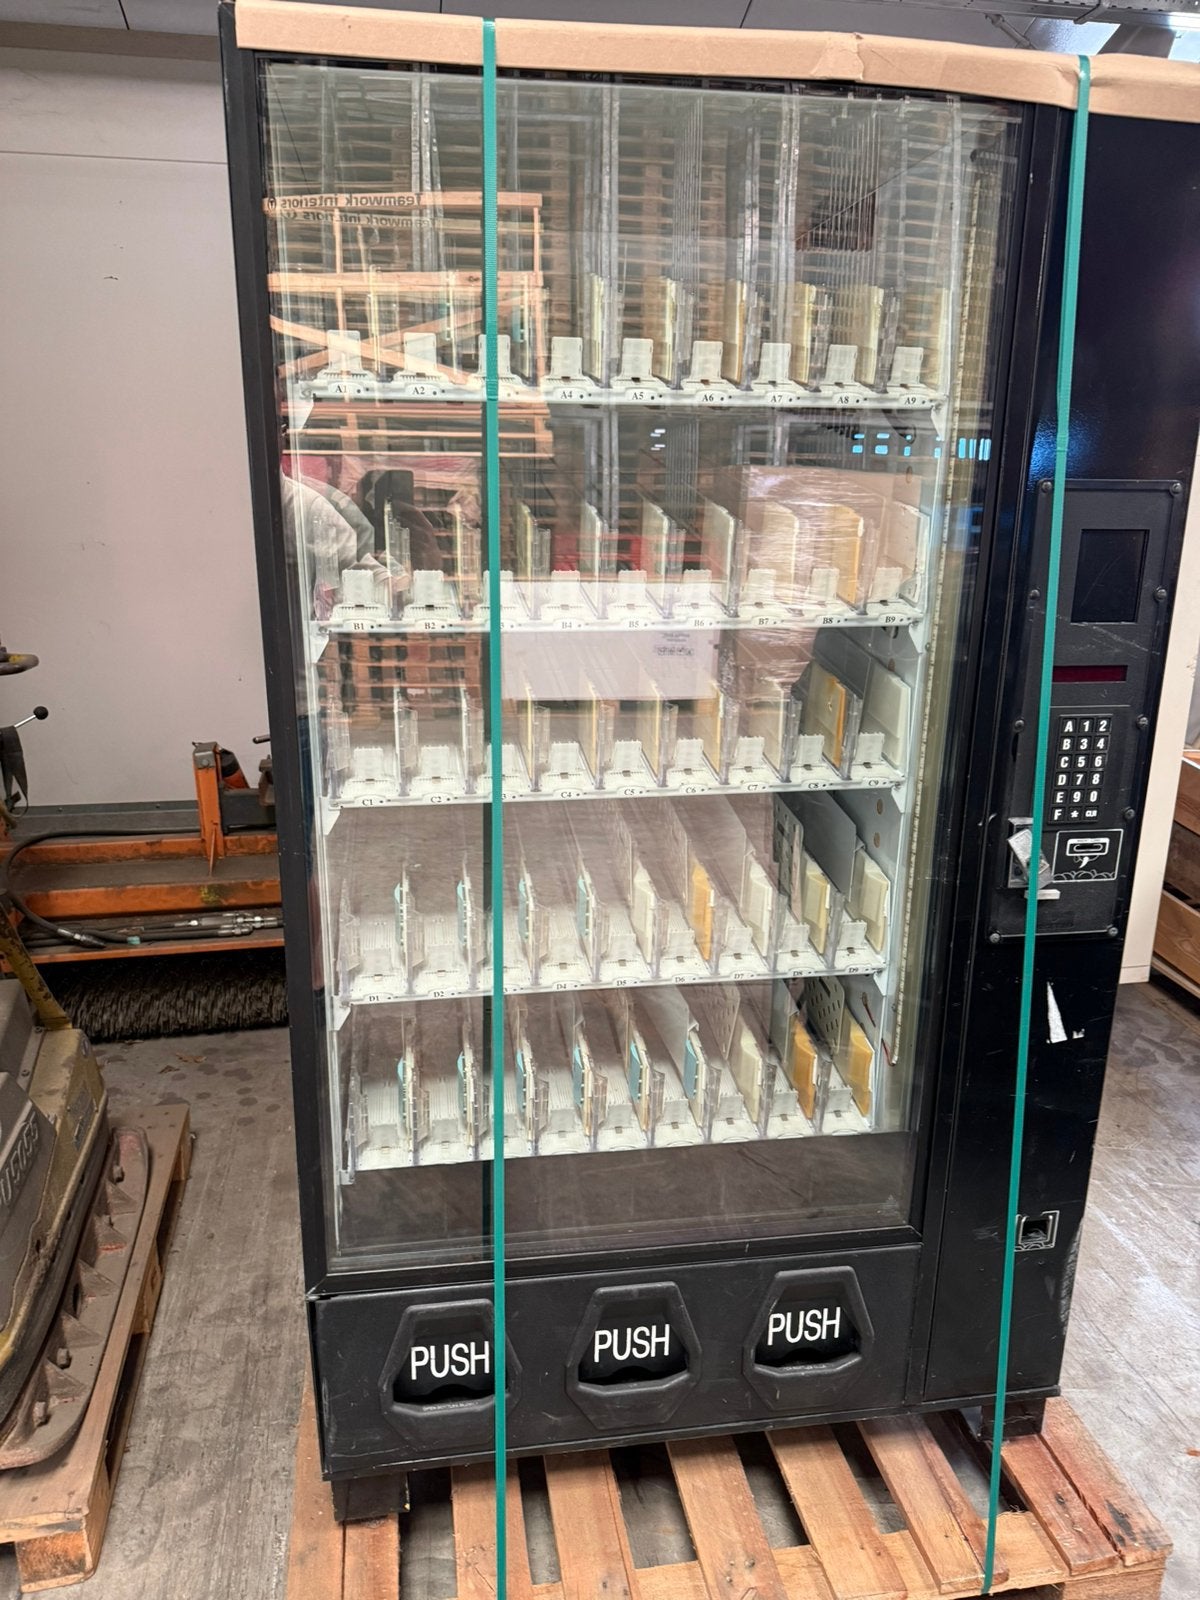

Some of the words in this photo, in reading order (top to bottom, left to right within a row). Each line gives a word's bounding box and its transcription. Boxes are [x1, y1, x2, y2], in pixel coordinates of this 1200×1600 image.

[335, 385, 347, 393] A1
[412, 386, 425, 395] A2
[560, 390, 573, 399] A4
[631, 391, 644, 400] A5
[702, 394, 714, 402] A6
[770, 395, 783, 403] A7
[837, 396, 849, 404] A8
[904, 397, 917, 405] A9
[424, 622, 436, 630] B2
[694, 619, 705, 627] B6
[822, 617, 833, 625] B8
[1064, 721, 1073, 732] A
[1083, 721, 1089, 731] 1
[1098, 720, 1107, 731] 2
[1062, 739, 1071, 750] B
[1079, 739, 1088, 749] 3
[1096, 738, 1104, 749] 4
[1060, 757, 1068, 768] C
[1077, 756, 1085, 767] 5
[1094, 756, 1102, 767] 6
[1057, 775, 1066, 785] D
[1075, 774, 1083, 785] 7
[1091, 774, 1100, 784] 8
[1055, 792, 1064, 802] E
[1072, 792, 1081, 802] 9
[1089, 791, 1097, 802] 0
[1053, 809, 1062, 820] F
[0, 1110, 39, 1206] U5055
[767, 1306, 841, 1346] PUSH
[593, 1324, 670, 1363] PUSH
[410, 1340, 490, 1381] PUSH
